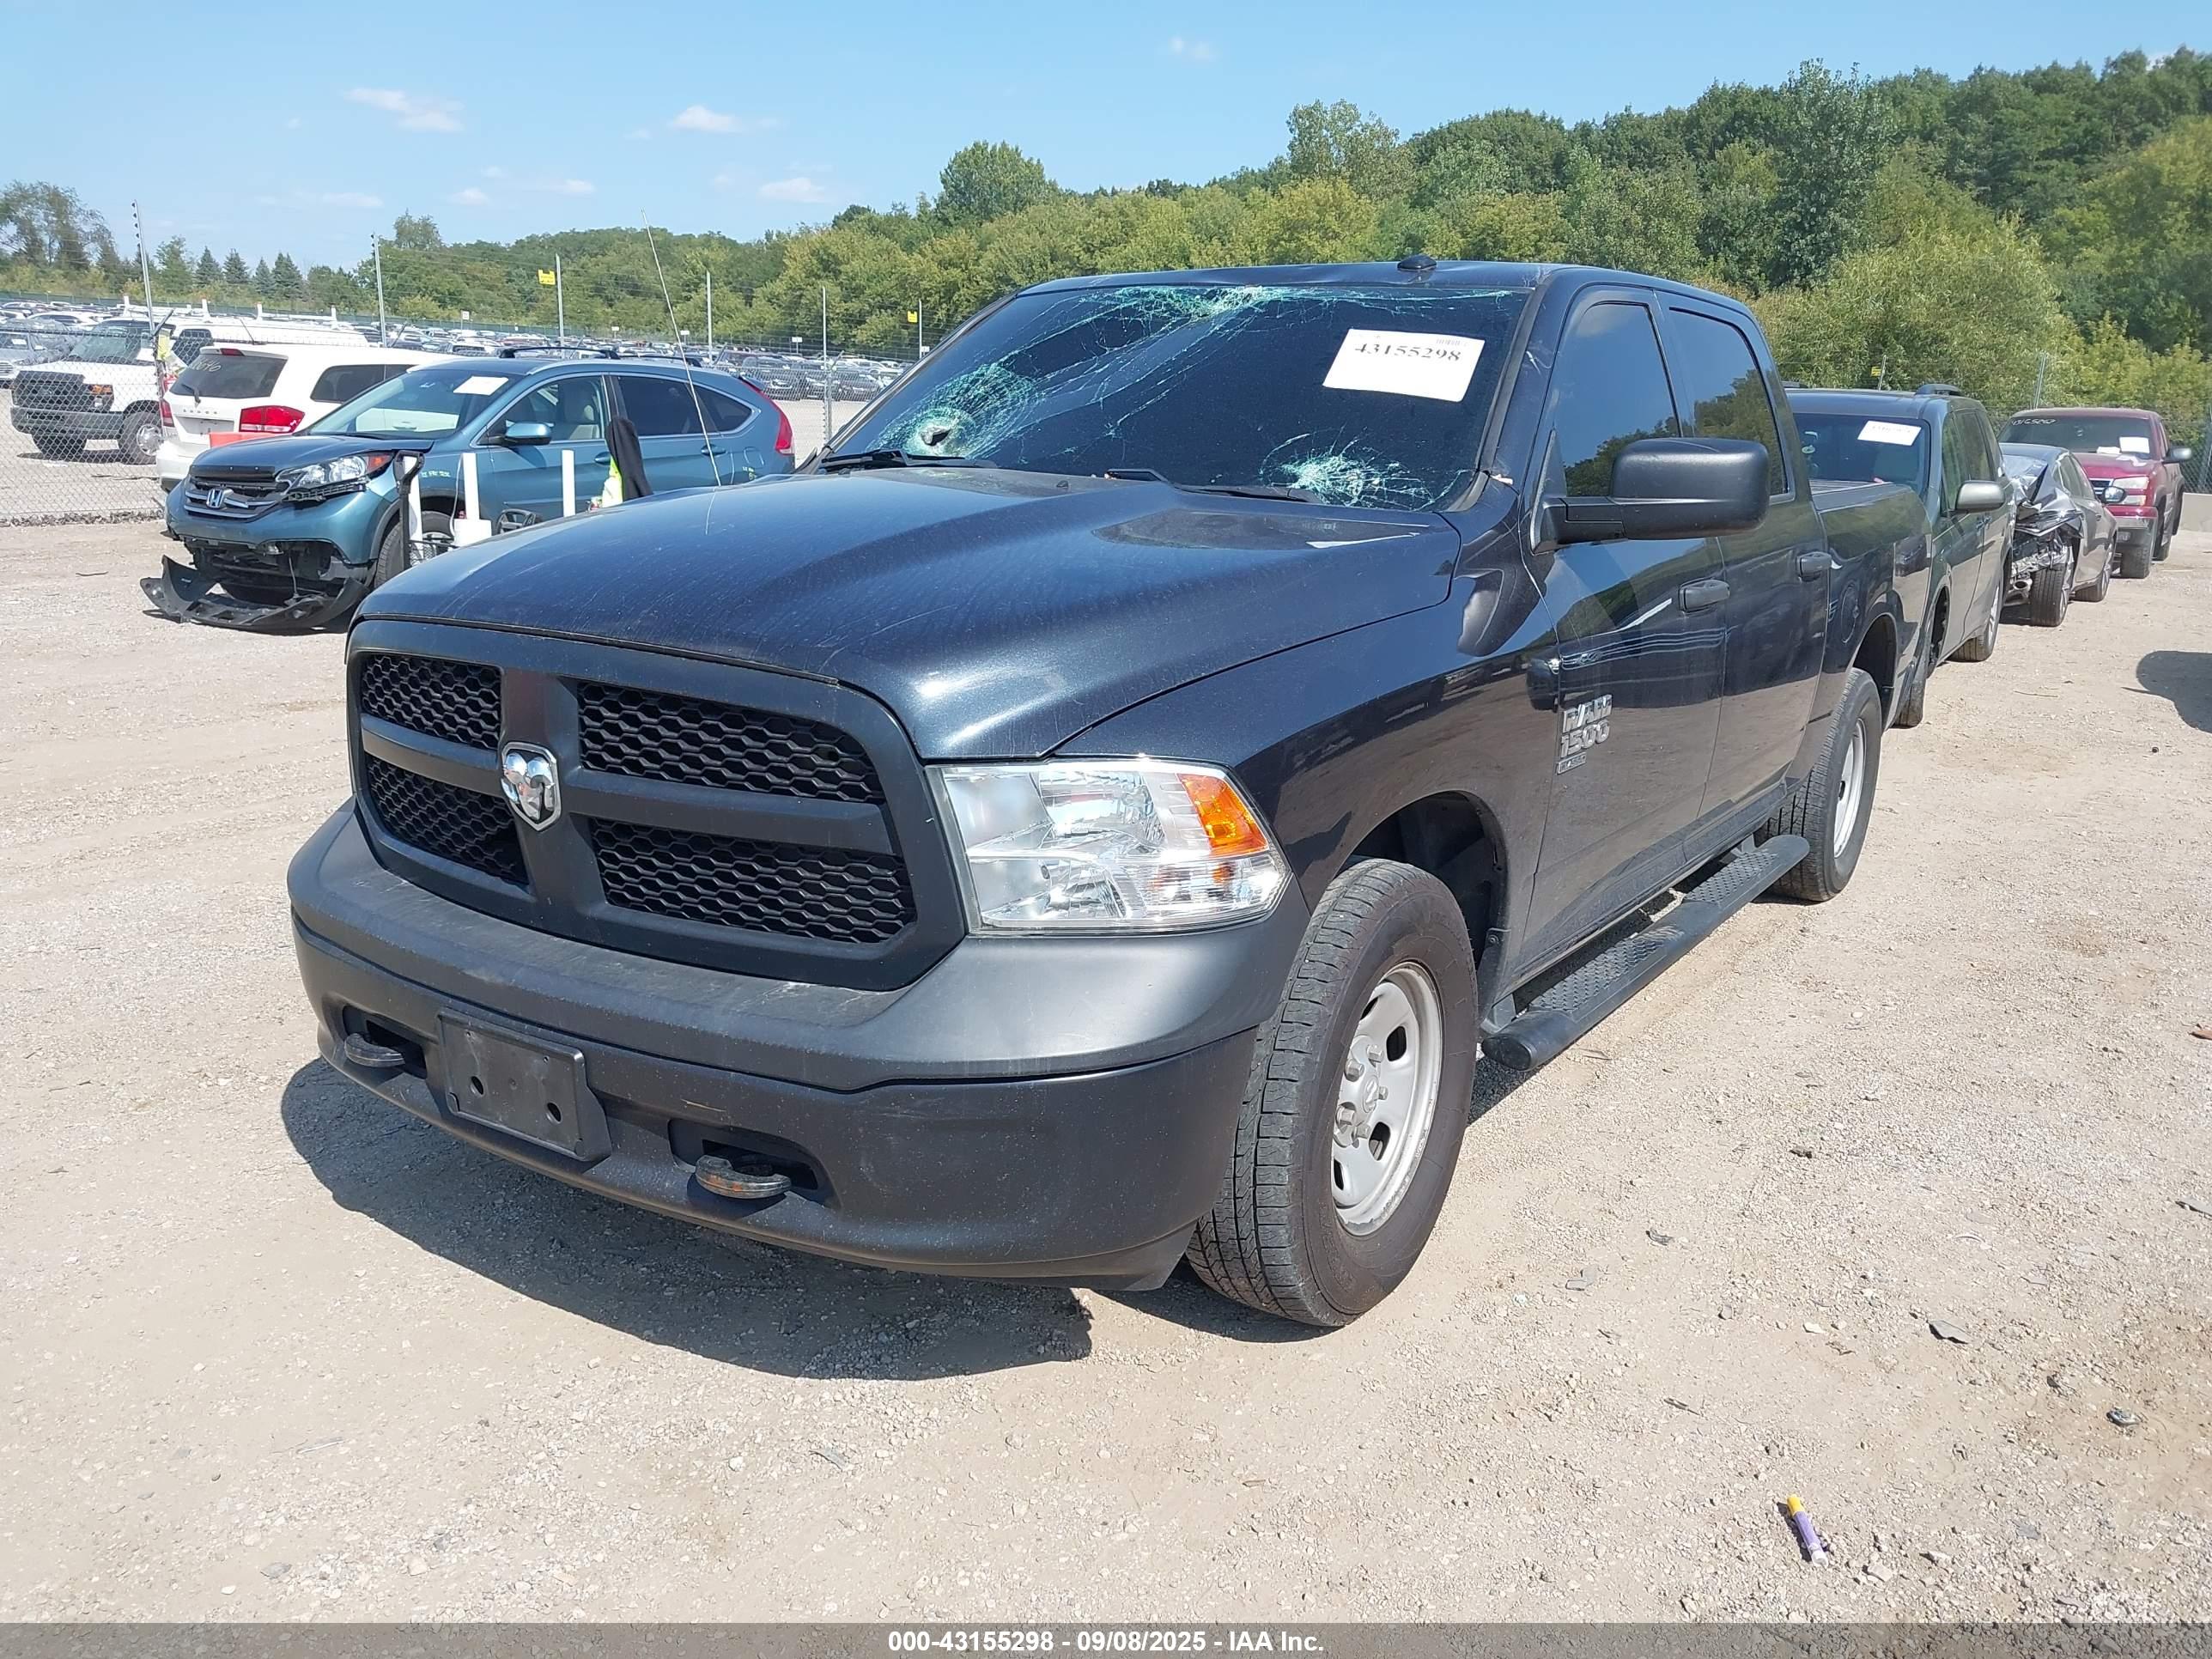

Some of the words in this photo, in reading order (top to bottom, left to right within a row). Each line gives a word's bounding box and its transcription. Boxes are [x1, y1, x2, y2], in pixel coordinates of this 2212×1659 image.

[1354, 343, 1462, 362] 43155298
[1562, 694, 1613, 733] RAM
[1560, 720, 1610, 758] 1500
